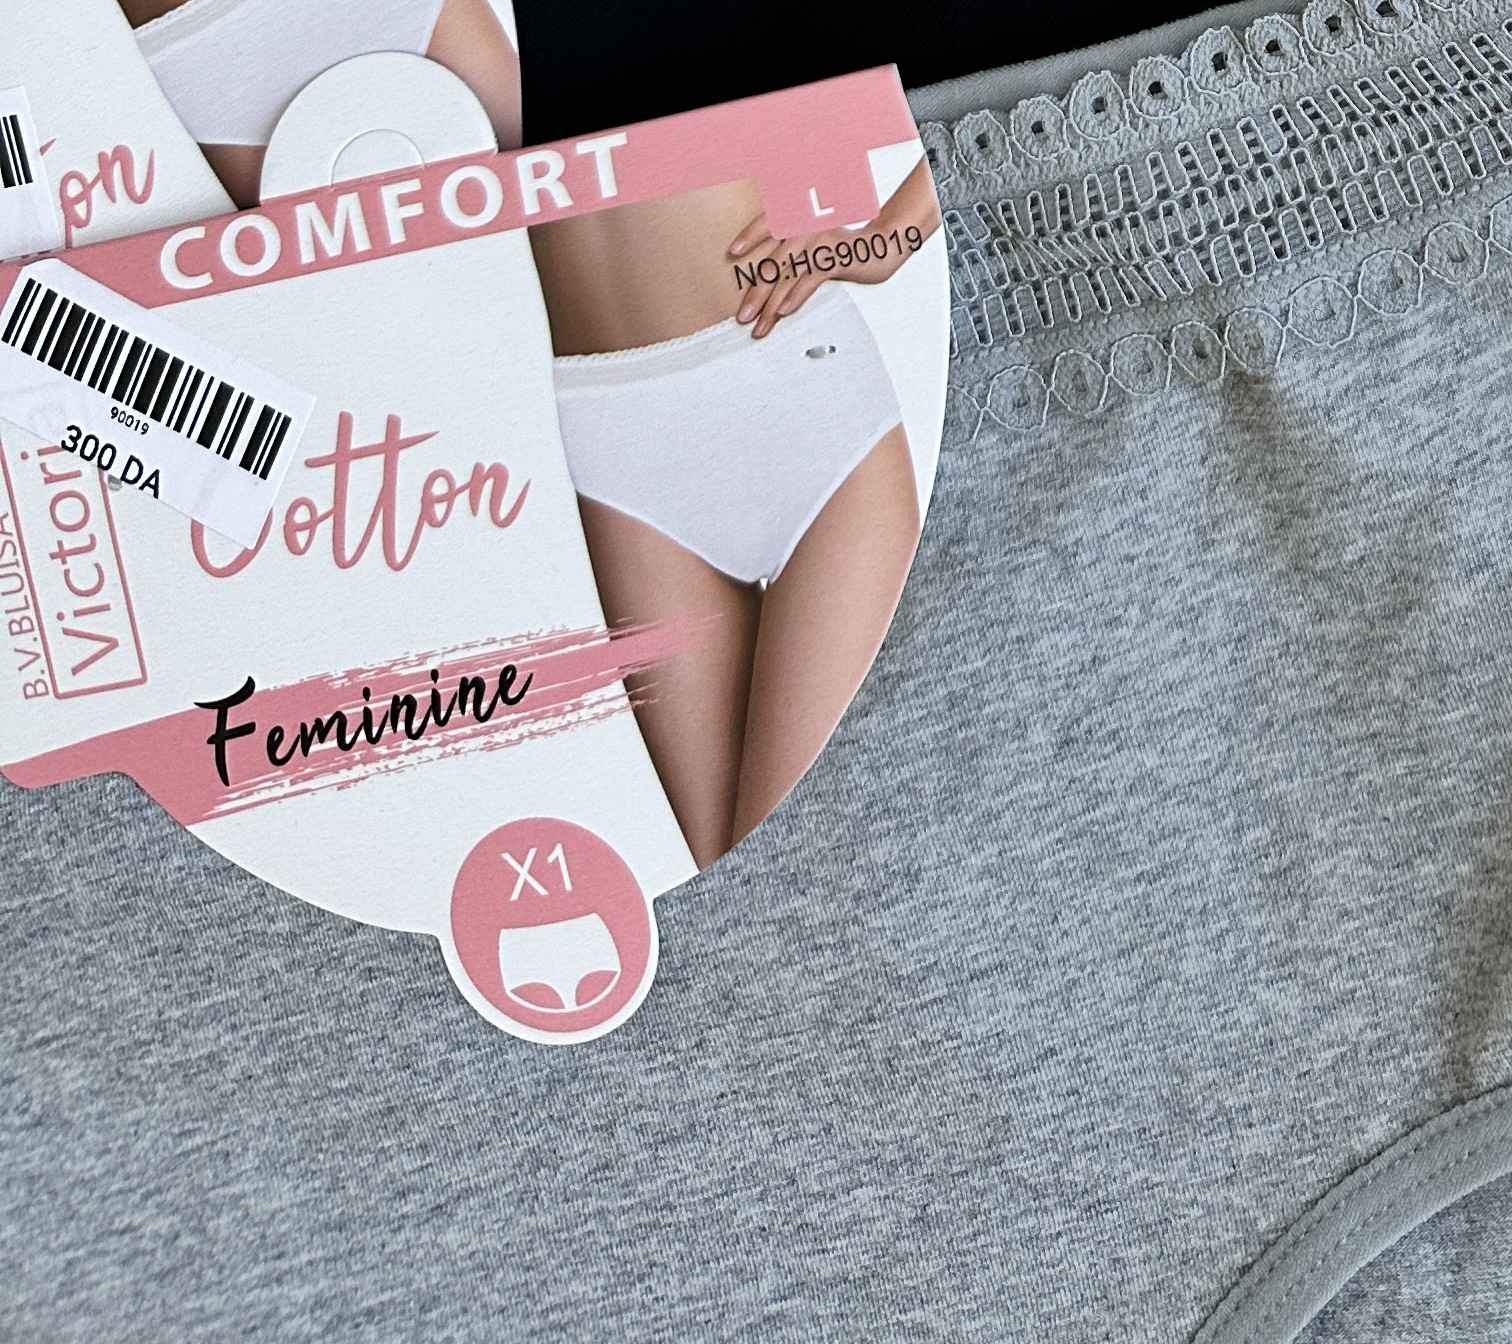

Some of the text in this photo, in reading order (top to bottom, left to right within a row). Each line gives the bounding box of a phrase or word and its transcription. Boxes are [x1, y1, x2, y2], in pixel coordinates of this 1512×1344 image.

[160, 133, 627, 289] COMFORT
[808, 186, 835, 217] L
[733, 225, 923, 290] NO:HG90019
[110, 406, 149, 435] 90019
[61, 424, 160, 499] 300 DA
[21, 445, 119, 676] Victori
[194, 663, 533, 787] Feminine
[502, 843, 574, 902] X1
